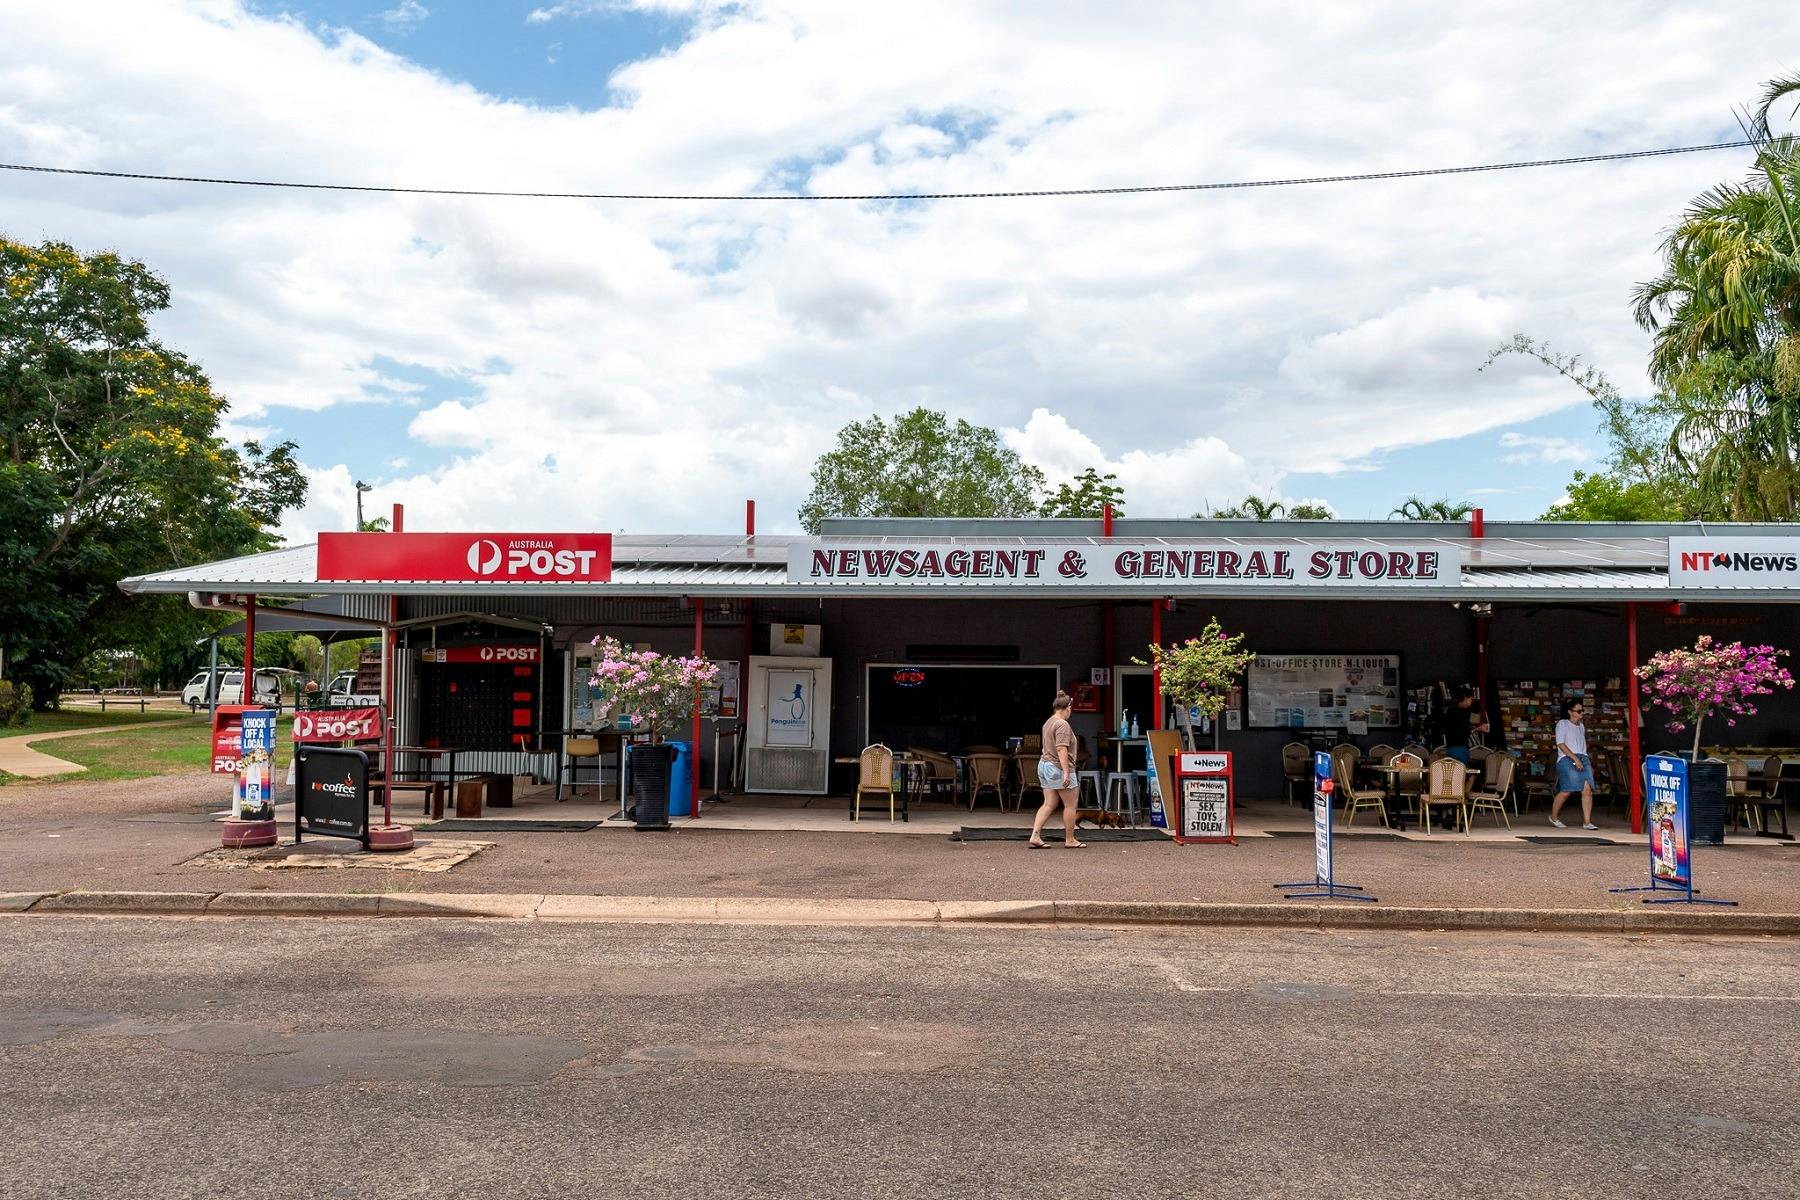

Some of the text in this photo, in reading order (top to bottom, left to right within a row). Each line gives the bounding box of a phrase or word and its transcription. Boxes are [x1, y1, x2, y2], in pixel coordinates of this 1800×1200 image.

[509, 541, 554, 549] AUSTRALIA
[508, 550, 597, 575] POST
[810, 549, 1438, 580] NEWSAGENT & GENERAL STORE
[1681, 552, 1798, 571] NT News
[496, 648, 537, 660] POST
[893, 671, 925, 682] OPEN
[243, 718, 266, 729] KNOCK
[317, 718, 373, 737] POST
[245, 729, 264, 739] OFF A
[244, 738, 266, 749] LOCAL
[214, 760, 243, 772] POS
[1201, 759, 1226, 767] News
[1190, 781, 1225, 790] NT News
[1650, 773, 1681, 791] KNOCK OFF
[322, 783, 356, 794] coffee
[1659, 789, 1677, 804] LOCAL
[1198, 802, 1215, 812] SEX
[1196, 811, 1217, 821] TOYS
[1191, 821, 1222, 832] STOLEN
